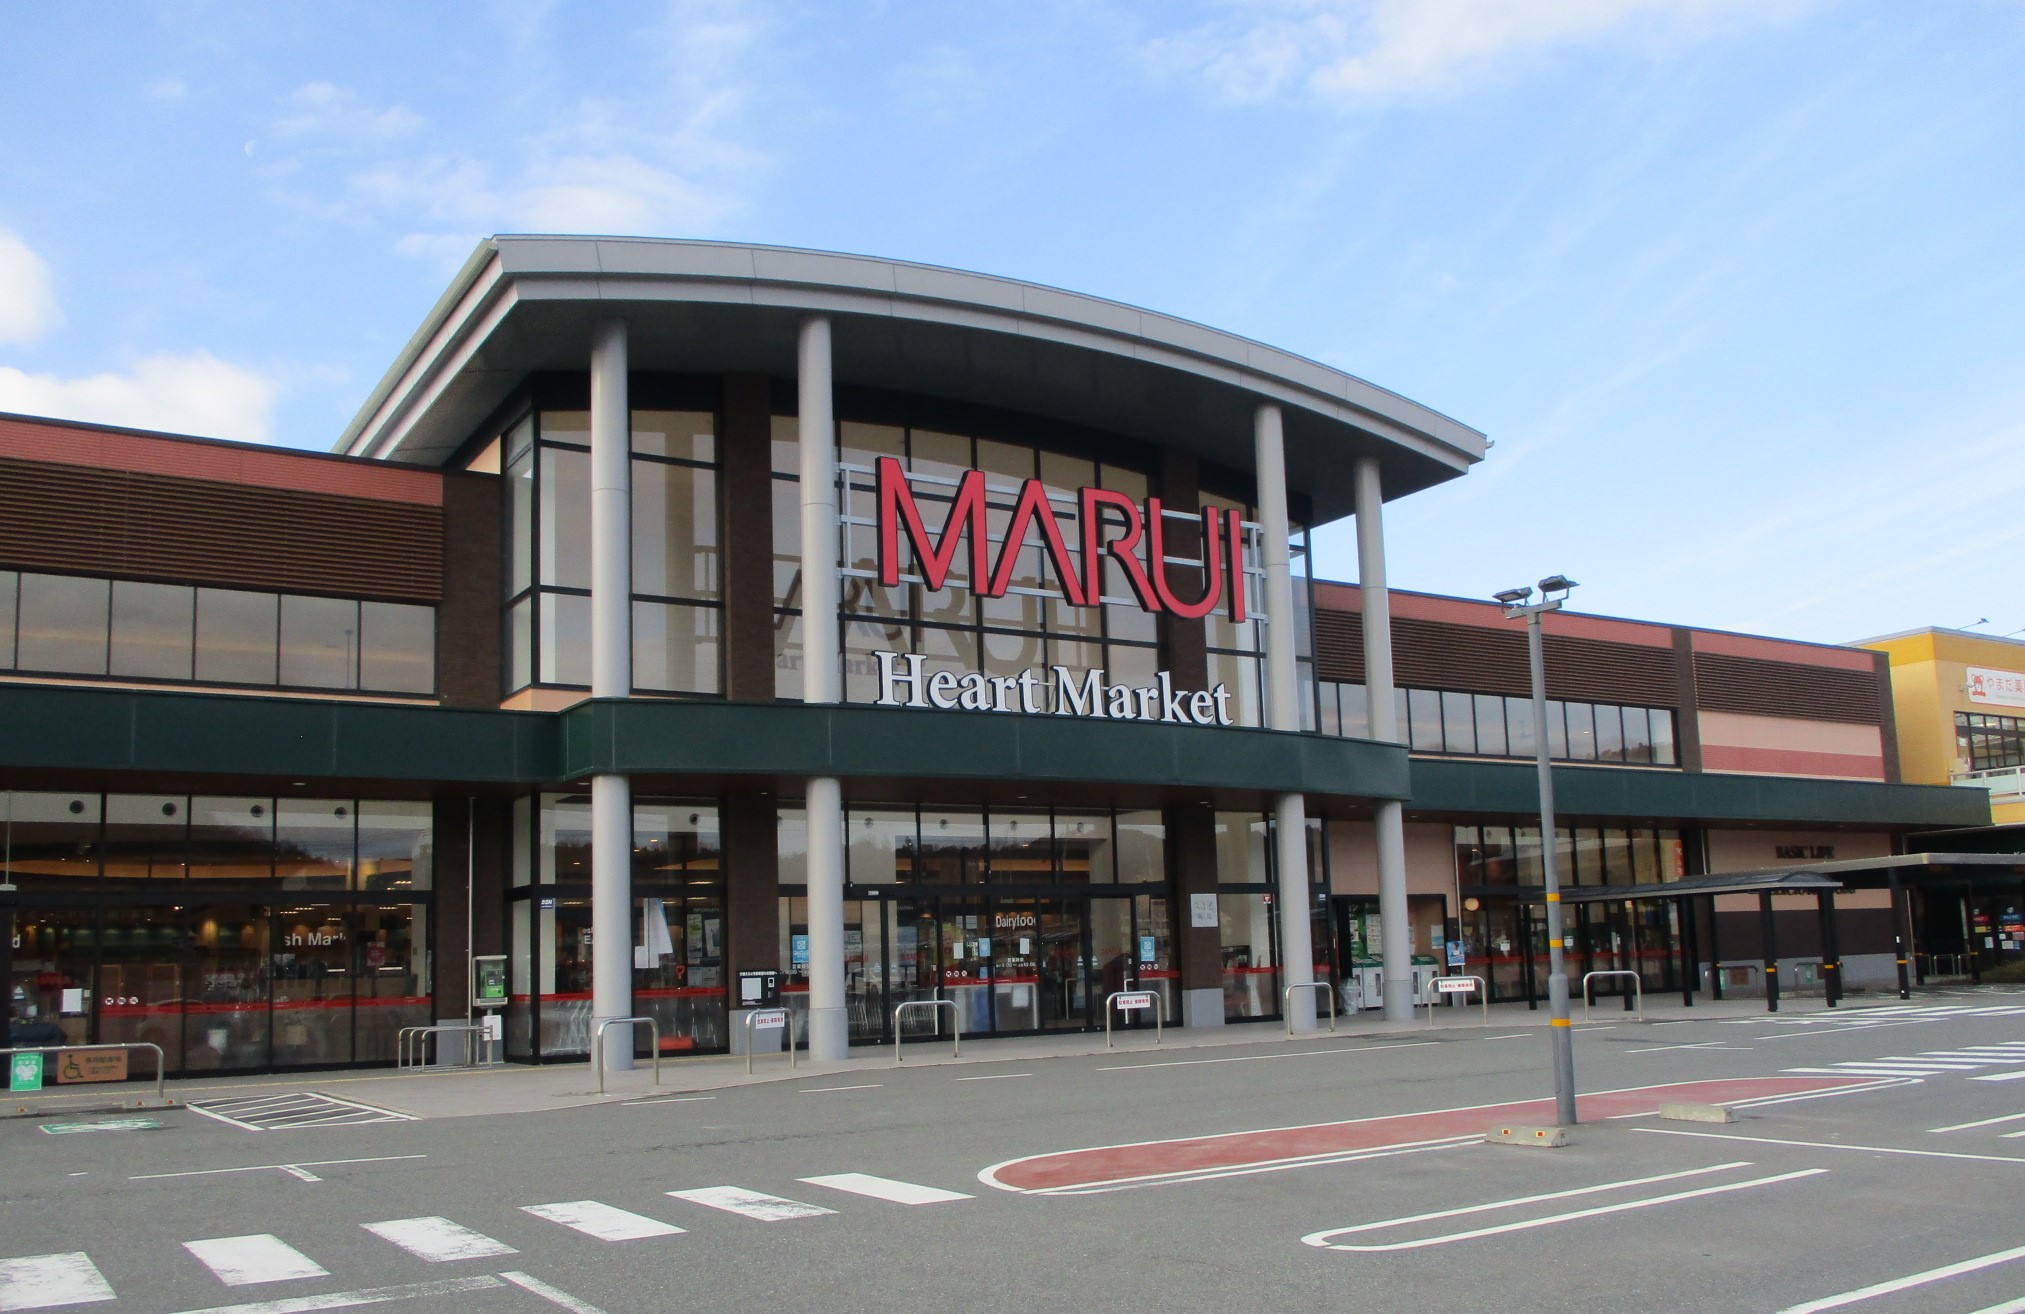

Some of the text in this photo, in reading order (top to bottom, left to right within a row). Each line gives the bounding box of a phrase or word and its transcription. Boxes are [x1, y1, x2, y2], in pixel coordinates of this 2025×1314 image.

[875, 456, 1246, 623] MARUI
[872, 650, 1235, 727] Heart Market
[1987, 676, 2025, 694] やまだ薬
